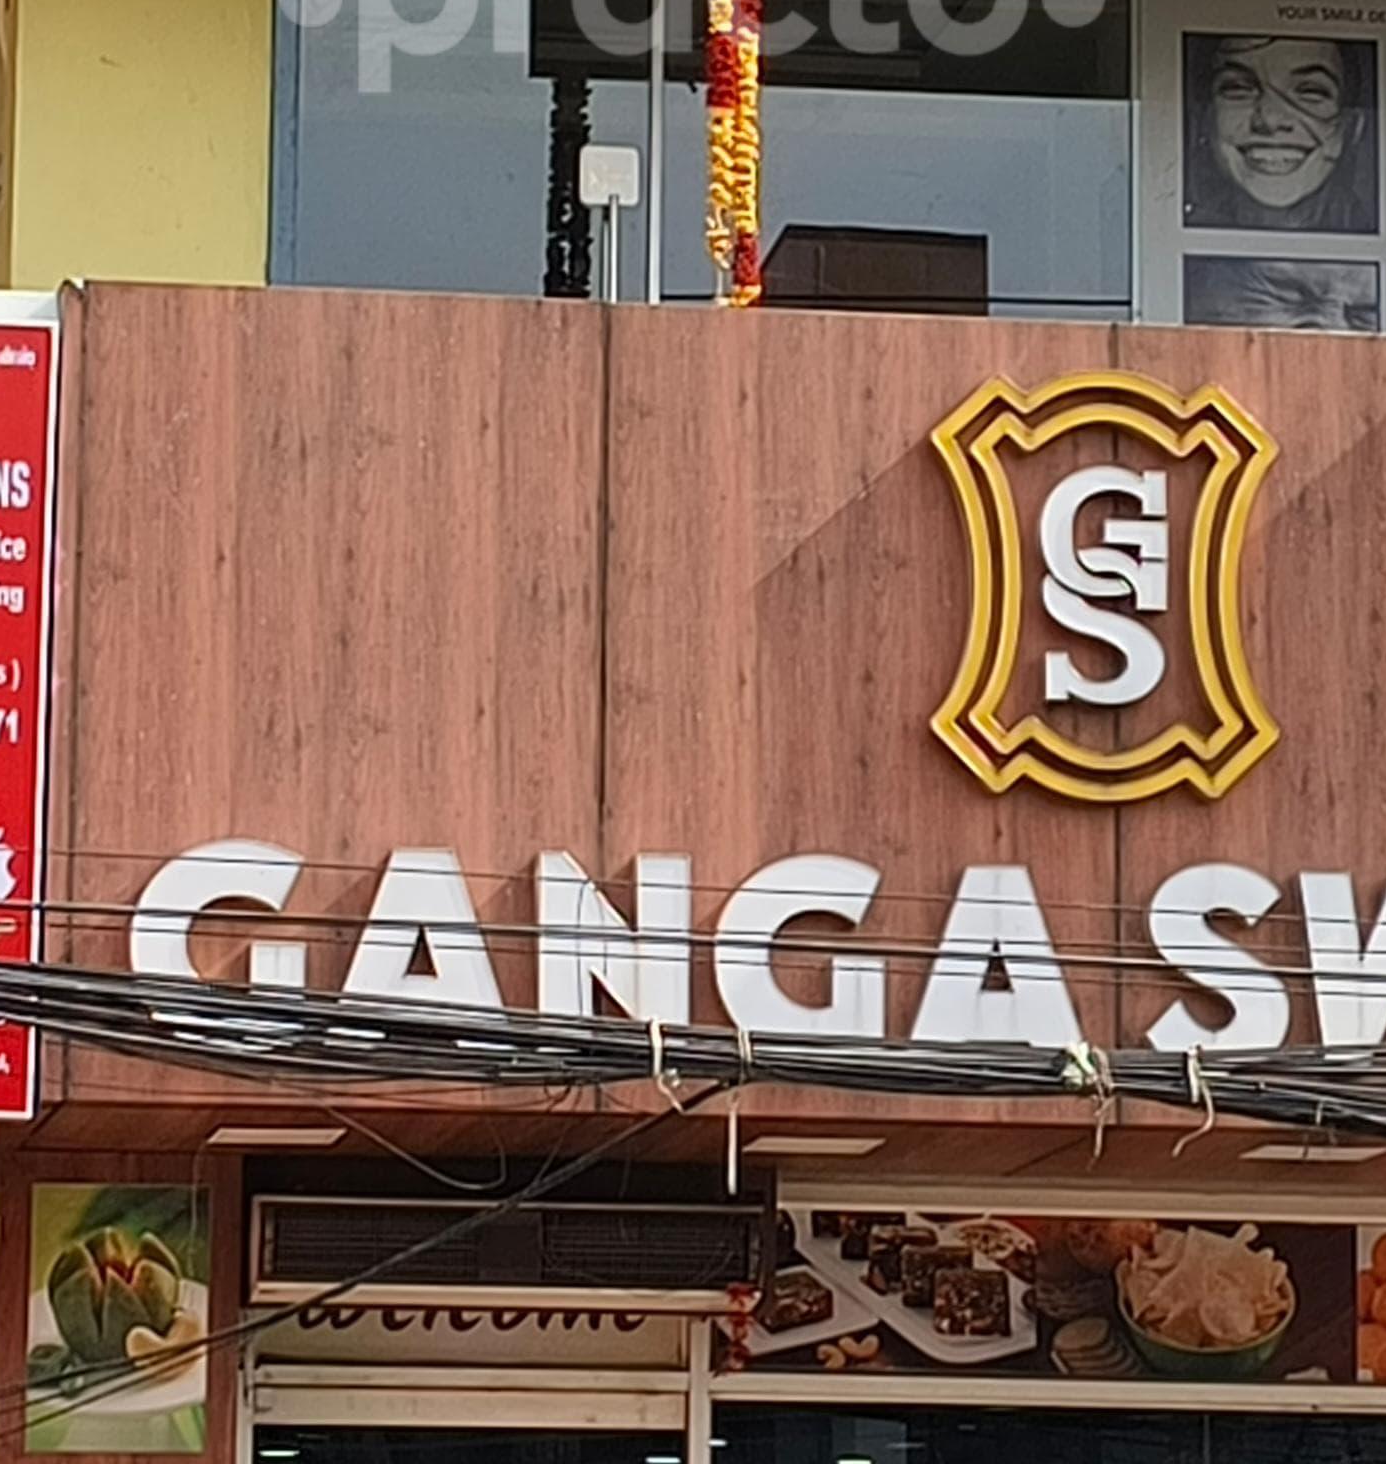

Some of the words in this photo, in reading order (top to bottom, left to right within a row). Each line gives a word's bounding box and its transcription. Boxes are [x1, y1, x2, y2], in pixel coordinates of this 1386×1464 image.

[1277, 5, 1317, 21] YOUR
[1320, 7, 1364, 23] SMILE
[129, 838, 1088, 1048] GANGA
